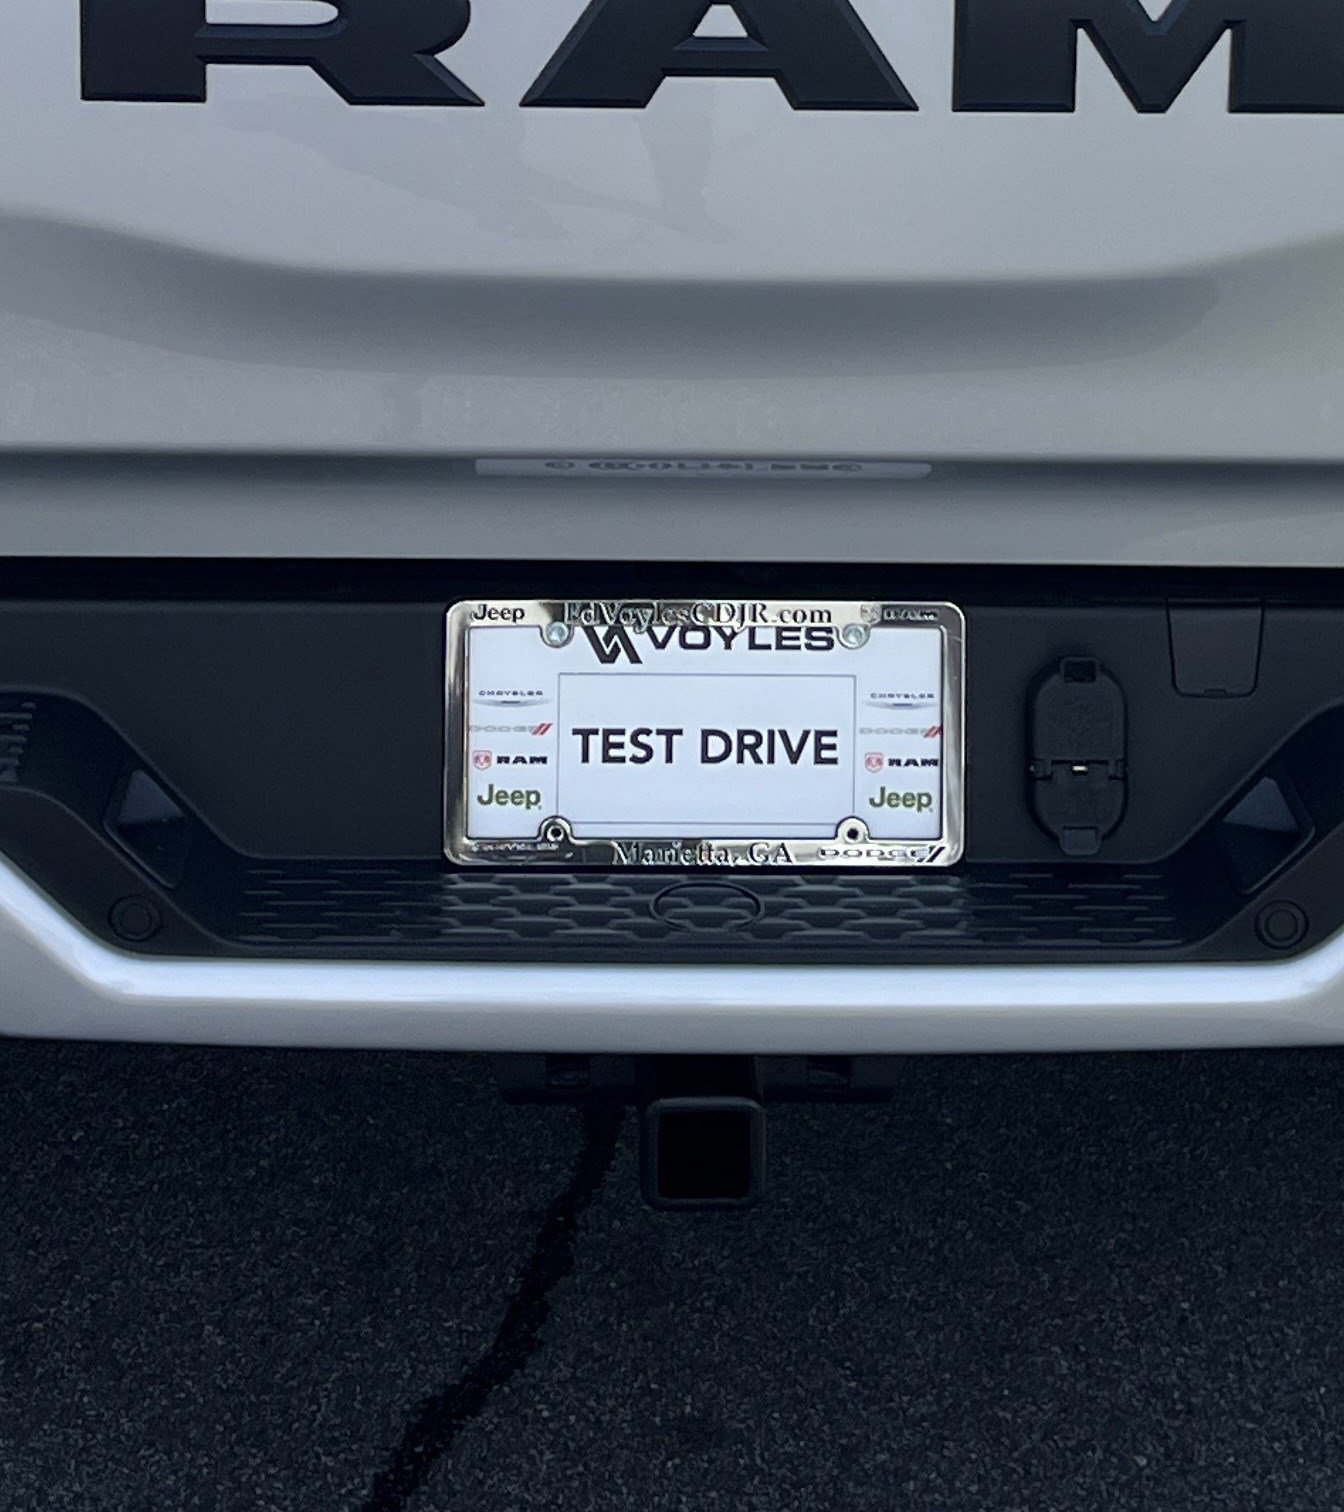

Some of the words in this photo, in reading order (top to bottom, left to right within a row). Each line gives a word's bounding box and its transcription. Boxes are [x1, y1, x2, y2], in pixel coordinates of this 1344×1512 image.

[473, 603, 526, 623] Jeep
[563, 601, 833, 633] EdVoylesCDJR.com
[646, 625, 836, 651] VOYLES
[572, 727, 683, 765] TEST
[700, 727, 840, 766] DRIVE
[496, 755, 548, 765] RAM
[887, 758, 940, 767] RAM
[477, 783, 542, 810] Jeep
[868, 786, 934, 813] Jeep
[748, 841, 794, 865] GA
